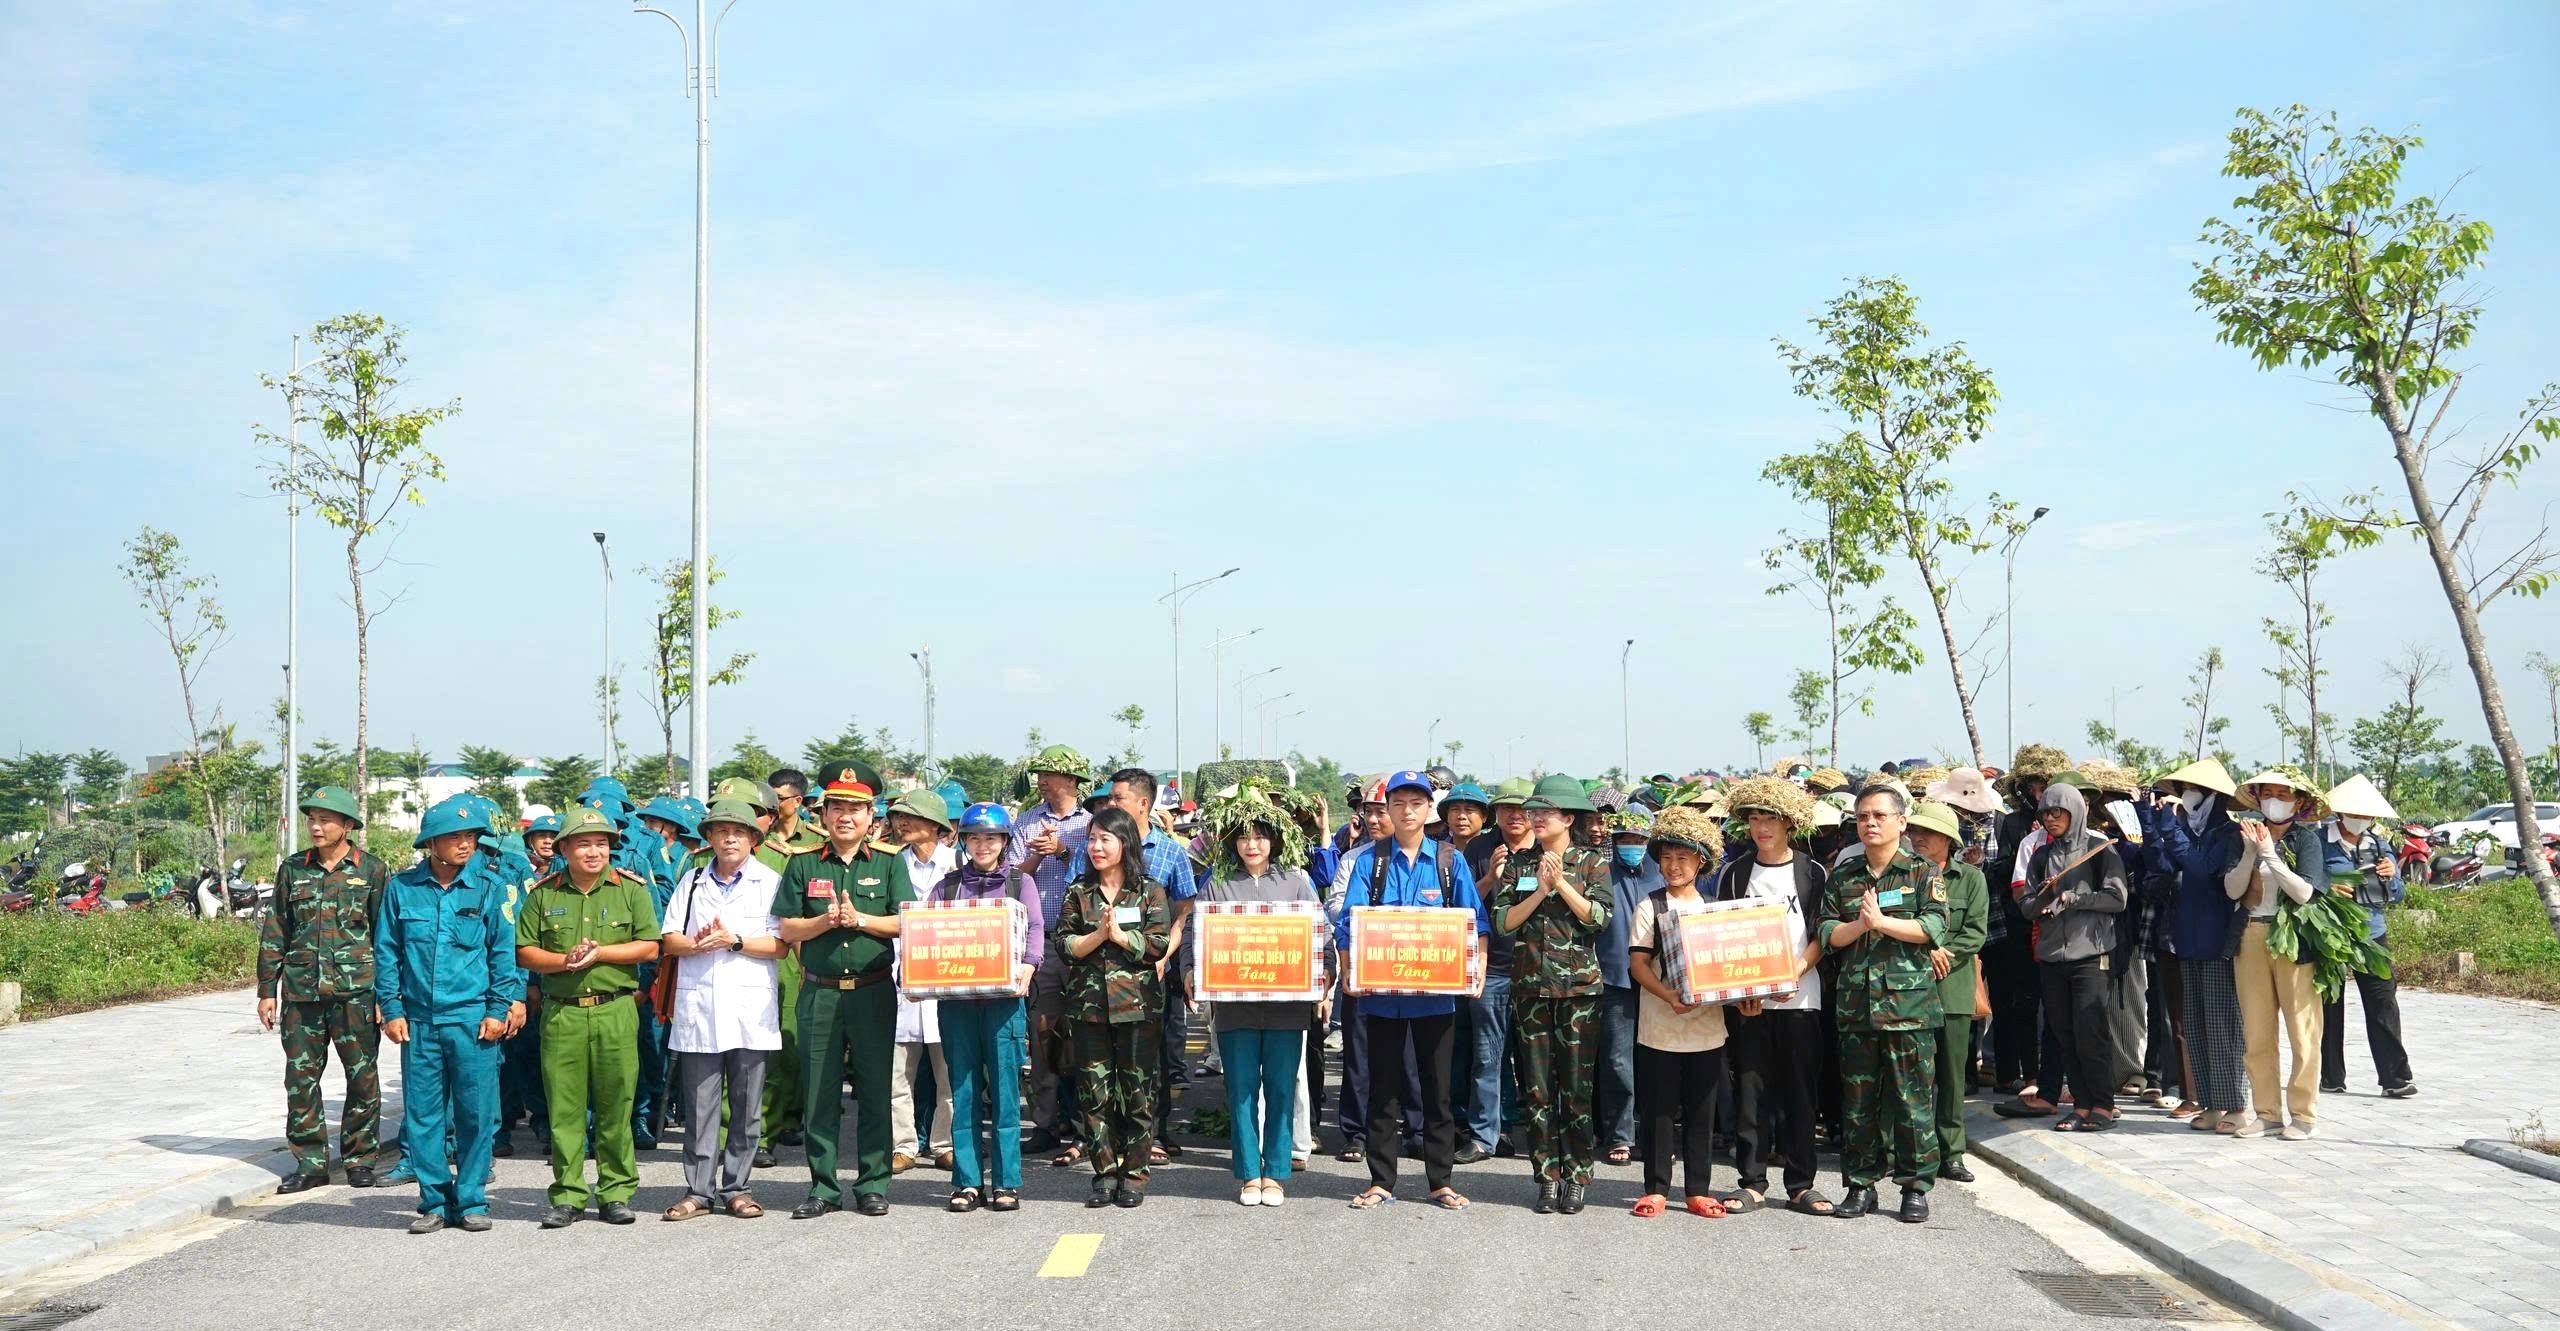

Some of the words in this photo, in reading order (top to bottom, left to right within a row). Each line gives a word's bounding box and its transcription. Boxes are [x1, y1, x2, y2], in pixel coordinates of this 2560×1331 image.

[912, 946, 928, 959] BAN
[931, 941, 940, 959] TỔ
[942, 943, 963, 959] CHỨC
[986, 941, 1001, 960] TẬP
[1213, 950, 1229, 964] BAN
[1232, 945, 1241, 964] TỔ
[1243, 947, 1264, 964] CHỨC
[1267, 946, 1285, 964] DIỄN
[1287, 947, 1302, 967] TẬP
[1367, 946, 1383, 960] BAN
[1386, 942, 1395, 960] TỔ
[1398, 945, 1418, 961] CHỨC
[1421, 944, 1439, 962] DIỄN
[1442, 946, 1456, 964] TẬP
[936, 961, 975, 976] Tặng
[1237, 967, 1276, 982] Tặng
[1391, 964, 1430, 979] Tặng
